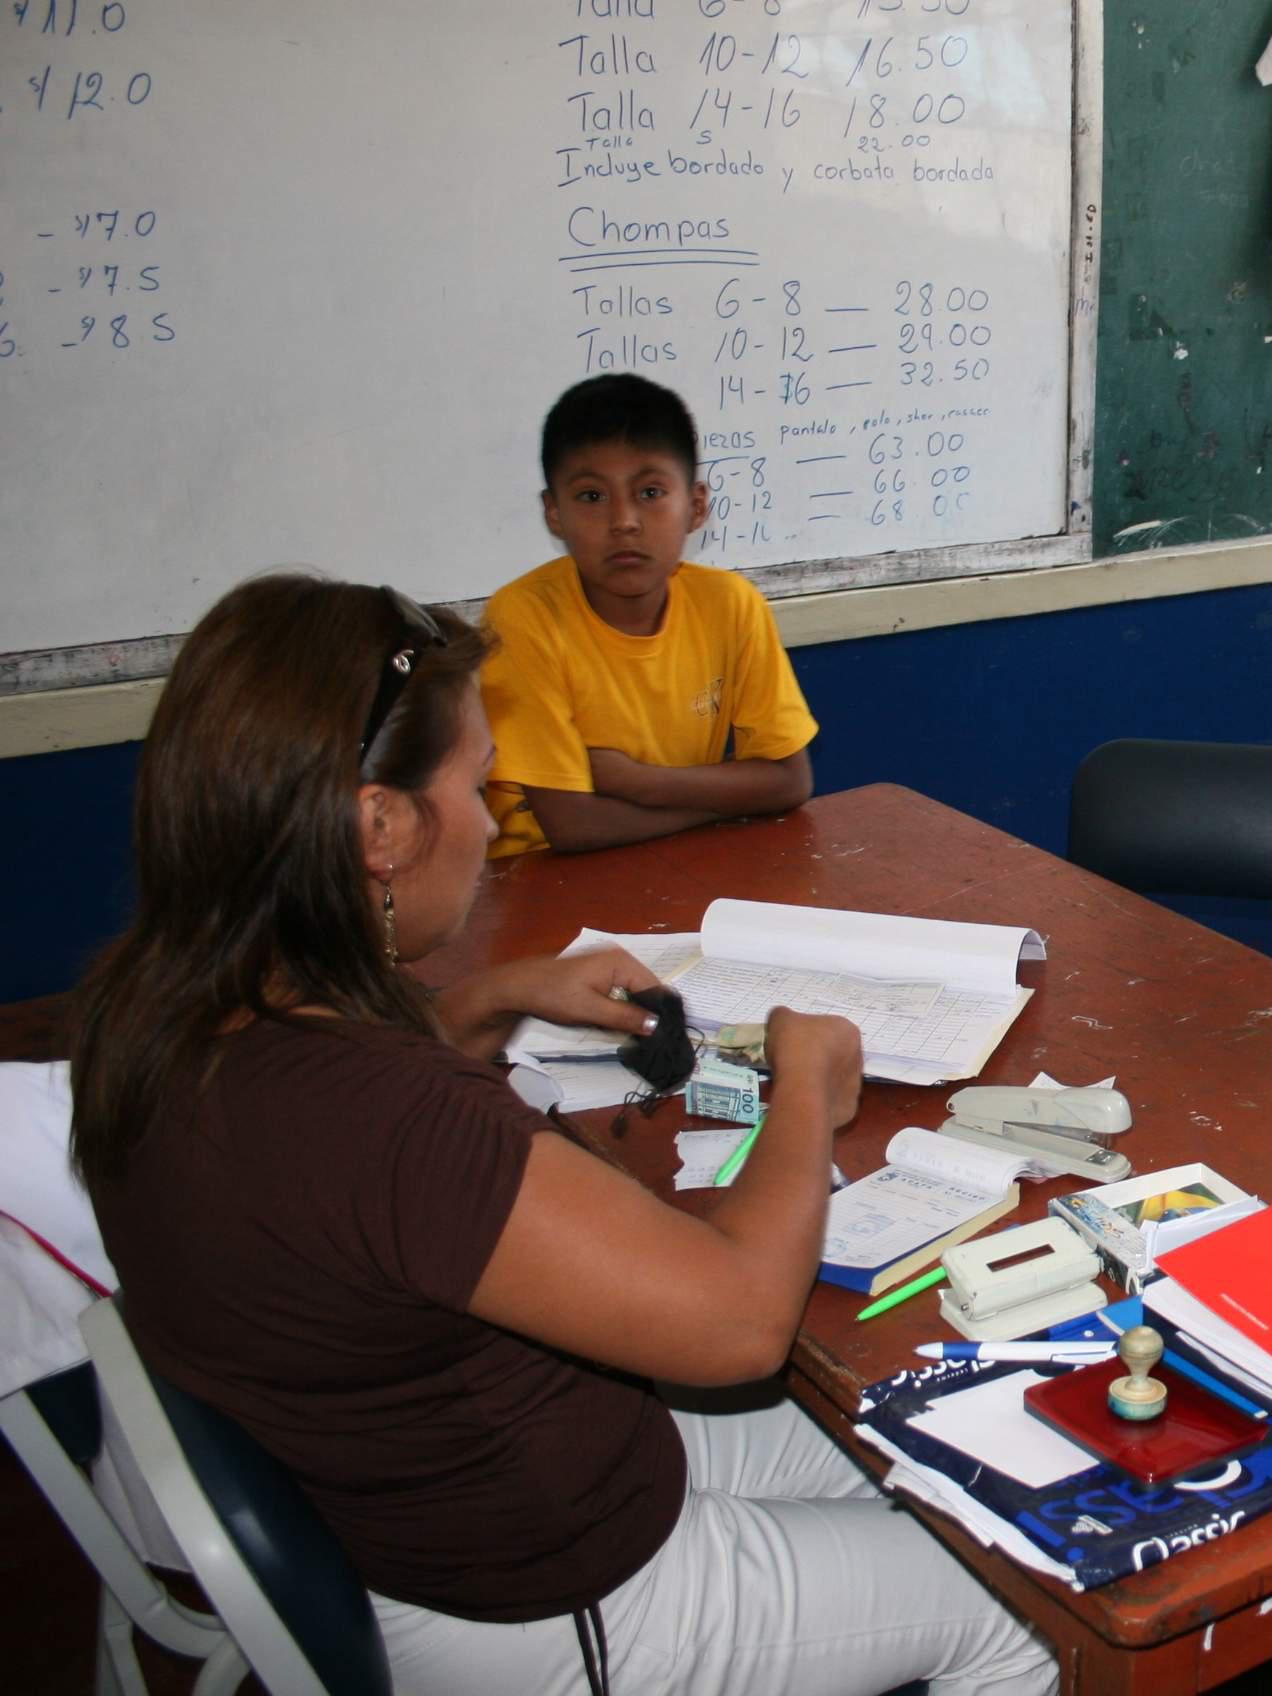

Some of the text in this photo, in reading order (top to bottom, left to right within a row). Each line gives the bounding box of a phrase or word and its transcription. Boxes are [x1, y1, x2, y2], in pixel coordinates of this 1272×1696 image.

[558, 33, 656, 76] Talla
[845, 36, 968, 87] 16.50
[567, 89, 655, 132] Talla
[844, 93, 965, 138] 18.00
[585, 135, 633, 150] Talla
[556, 147, 994, 193] Incluye bordado y corbata bordada
[568, 206, 730, 247] Chompas
[572, 285, 673, 316] Tallas
[894, 280, 989, 317] 28.00
[577, 327, 678, 373] Tallas
[898, 323, 992, 354] 29.00
[900, 358, 990, 387] 32.50
[694, 430, 756, 450] iezas
[868, 431, 965, 465] 63.00
[873, 465, 971, 495] 66.00
[742, 1087, 755, 1113] 100
